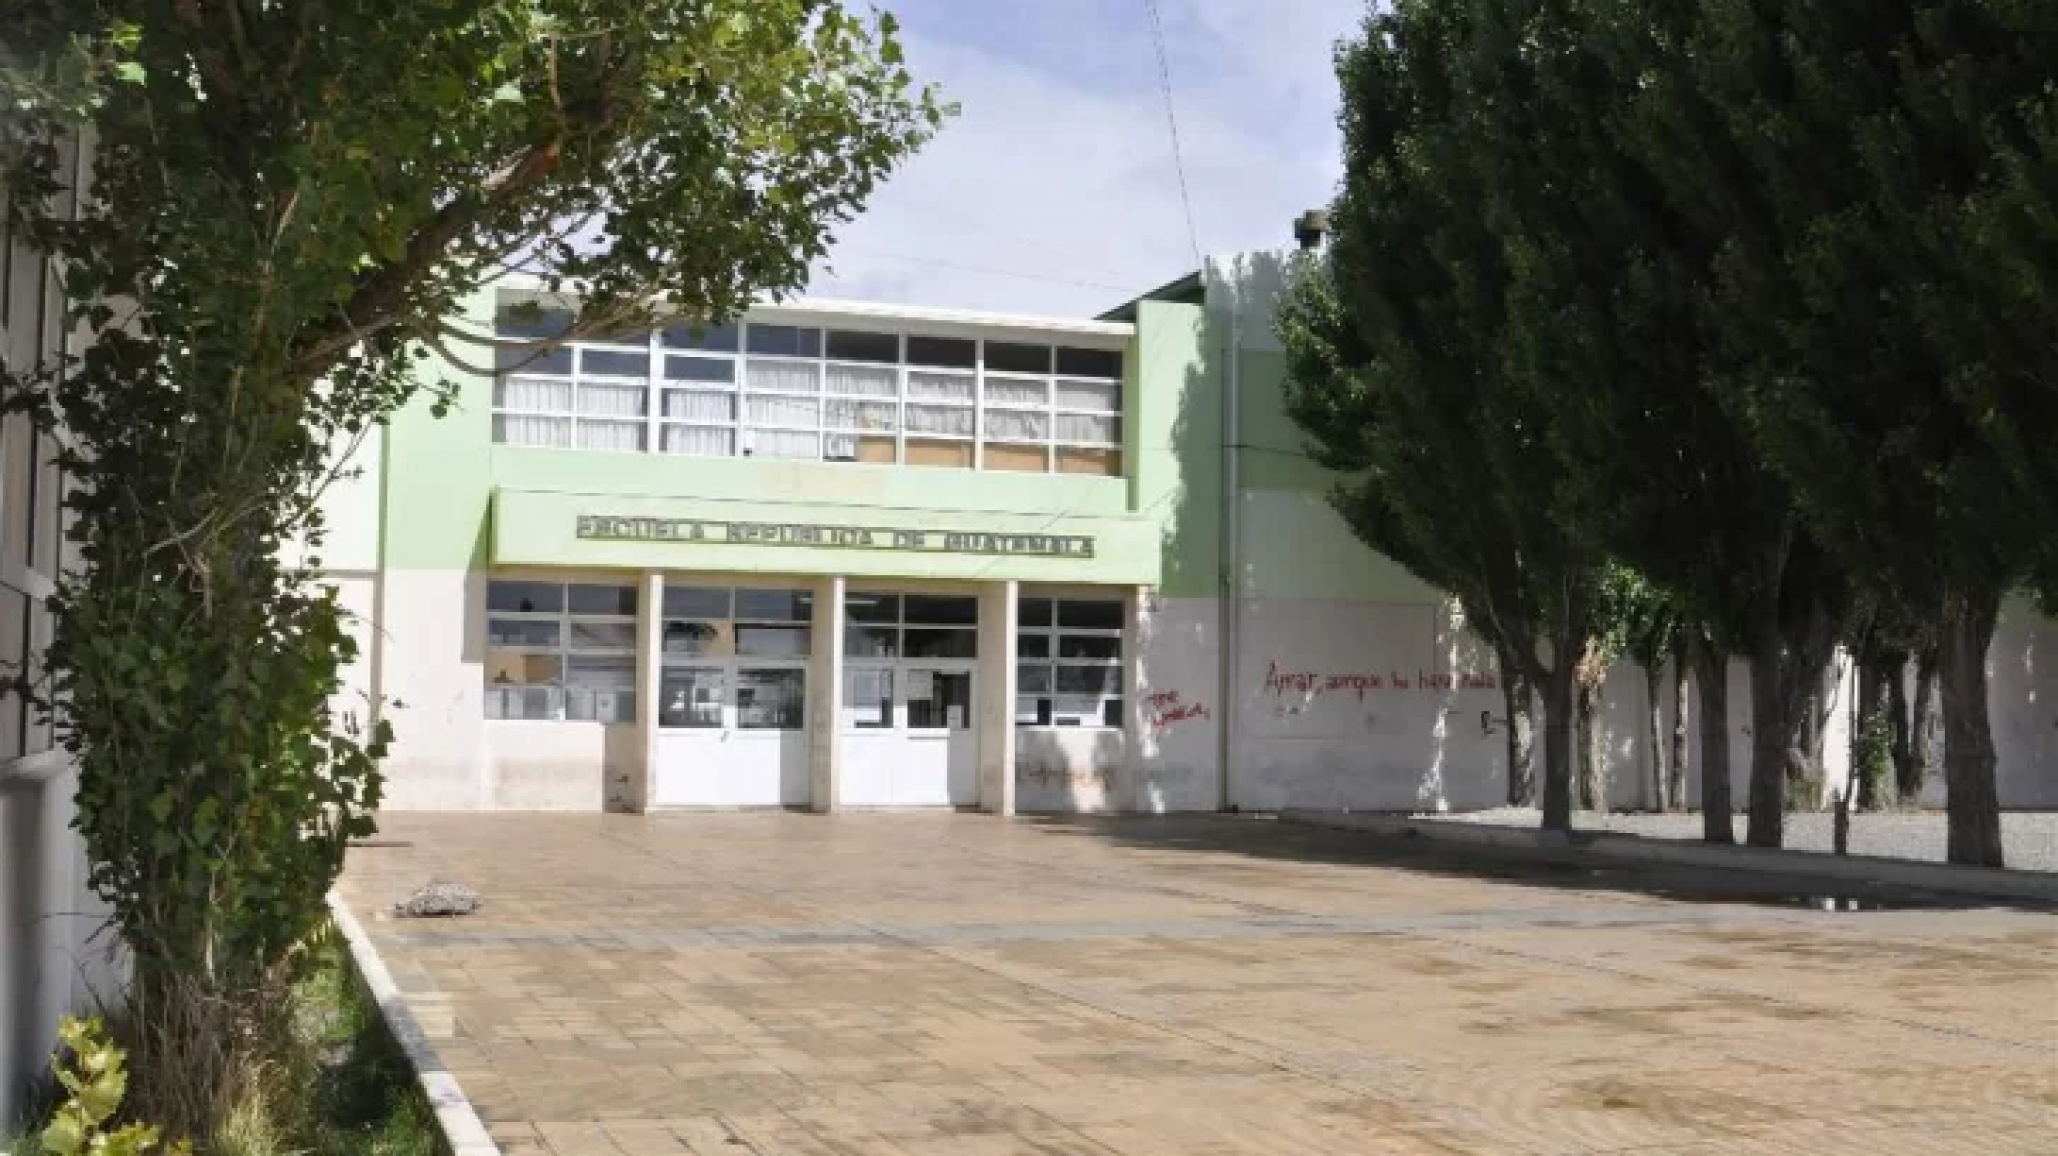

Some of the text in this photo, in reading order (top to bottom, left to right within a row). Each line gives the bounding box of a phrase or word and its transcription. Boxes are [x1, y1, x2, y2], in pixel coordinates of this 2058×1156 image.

[576, 515, 706, 543] ESCUELA
[892, 529, 926, 552] DE
[944, 531, 1094, 559] GUATEMALA
